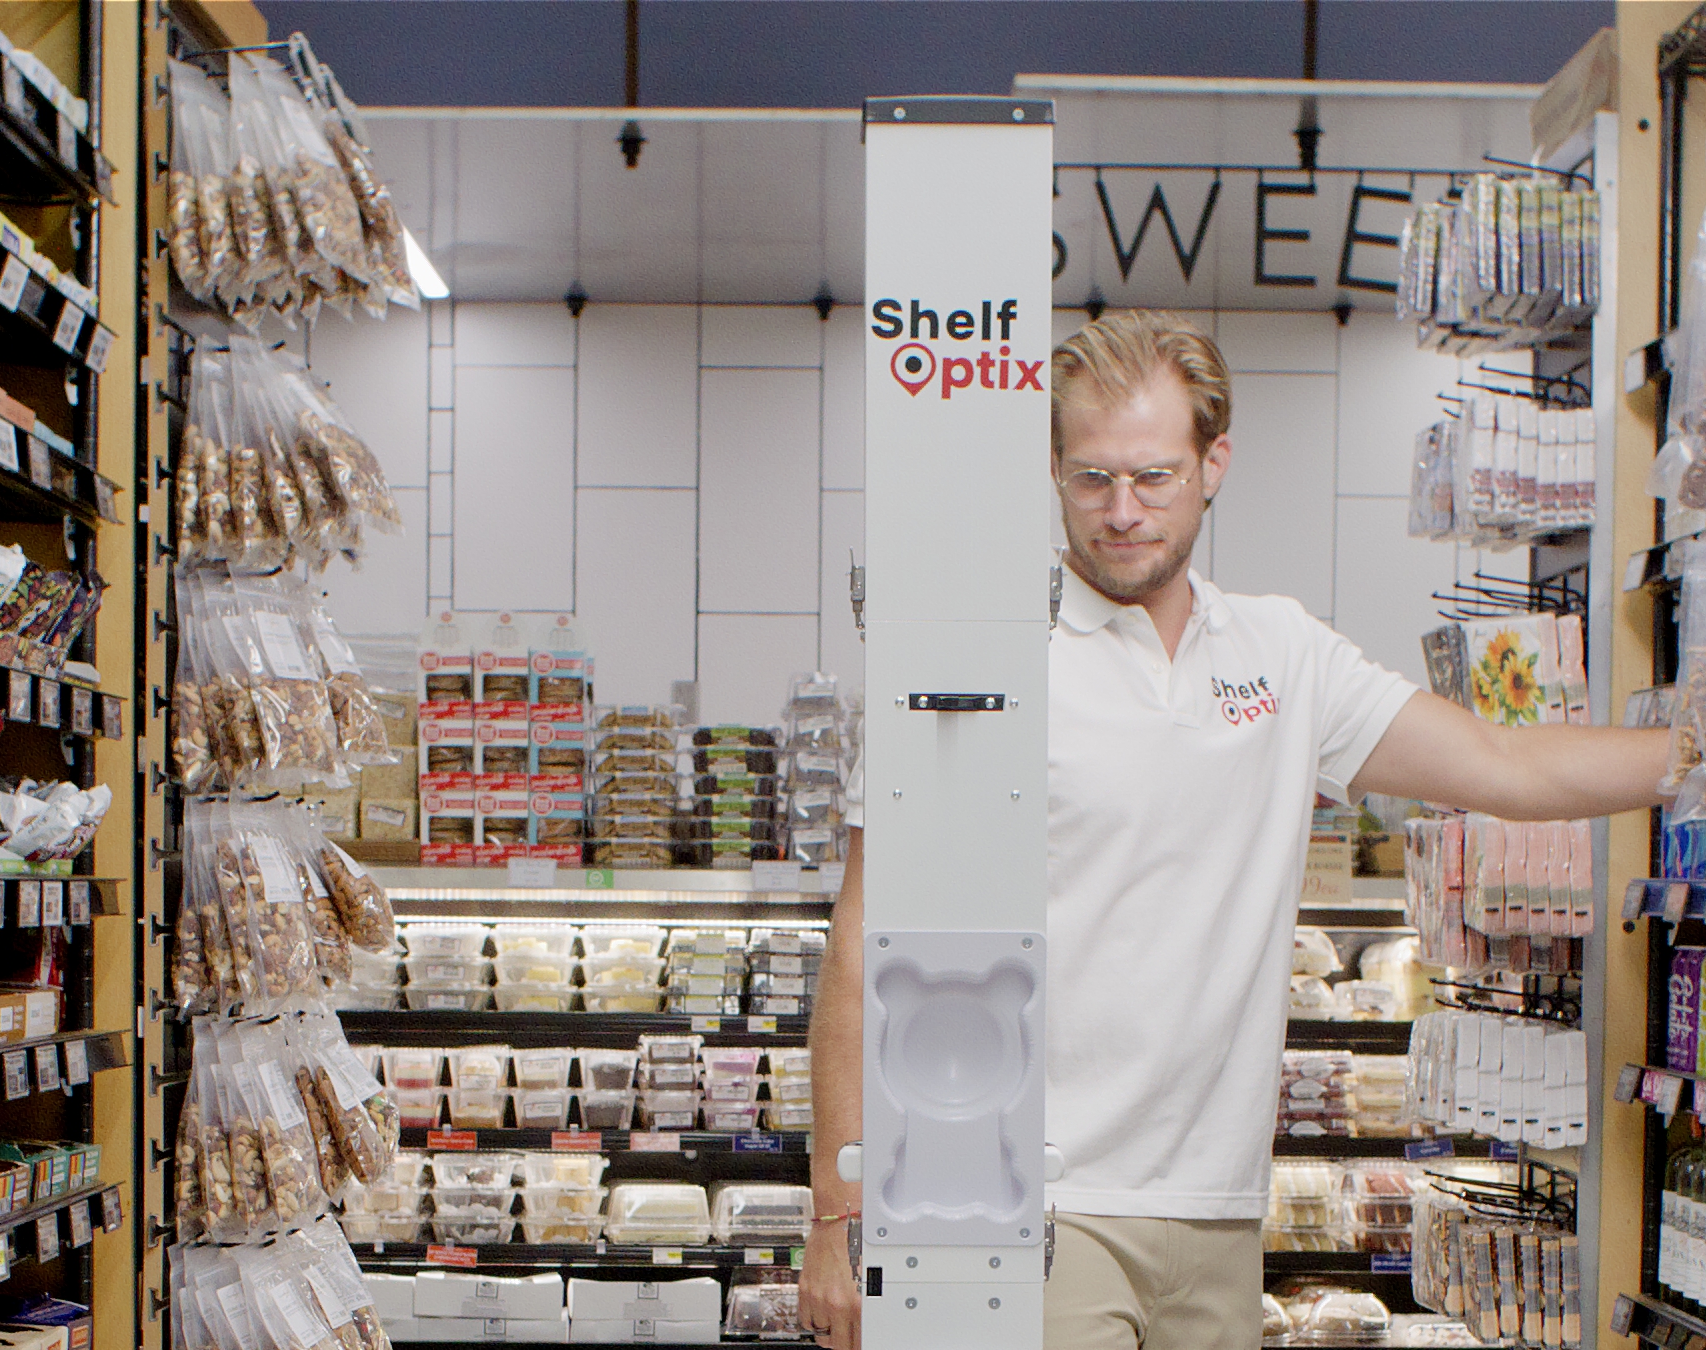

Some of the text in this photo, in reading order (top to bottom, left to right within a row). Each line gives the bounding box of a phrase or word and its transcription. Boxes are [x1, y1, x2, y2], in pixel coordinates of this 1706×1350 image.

[1053, 180, 1412, 293] WEE
[870, 298, 1018, 341] Shelf
[1211, 674, 1269, 700] Shelf
